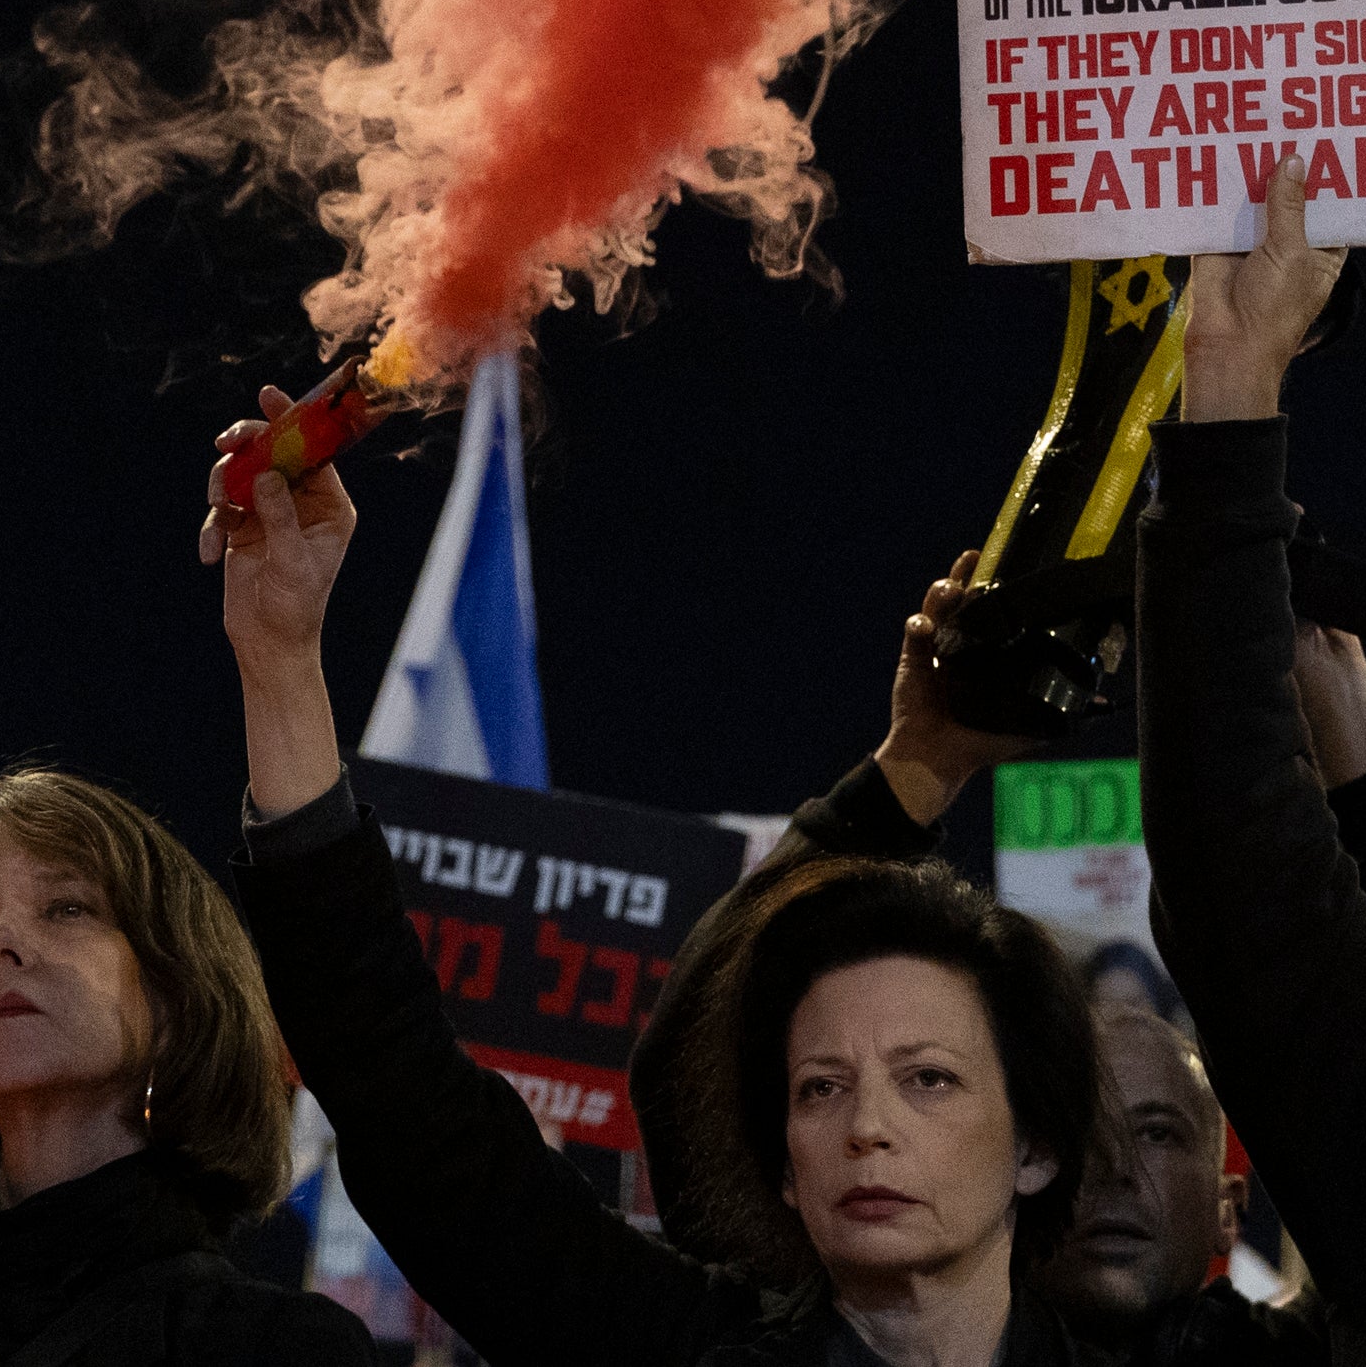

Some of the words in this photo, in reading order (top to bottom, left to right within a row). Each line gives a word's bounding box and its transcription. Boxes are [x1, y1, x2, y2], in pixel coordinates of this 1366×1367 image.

[985, 37, 1029, 84] IF
[1037, 30, 1160, 80] THEY
[1169, 22, 1305, 74] DON'T
[987, 85, 1135, 145] THEY
[1149, 79, 1268, 138] ARE
[989, 144, 1219, 217] DEATH
[381, 825, 525, 897] שבויי
[534, 854, 669, 928] פדיון
[536, 920, 672, 1027] כל
